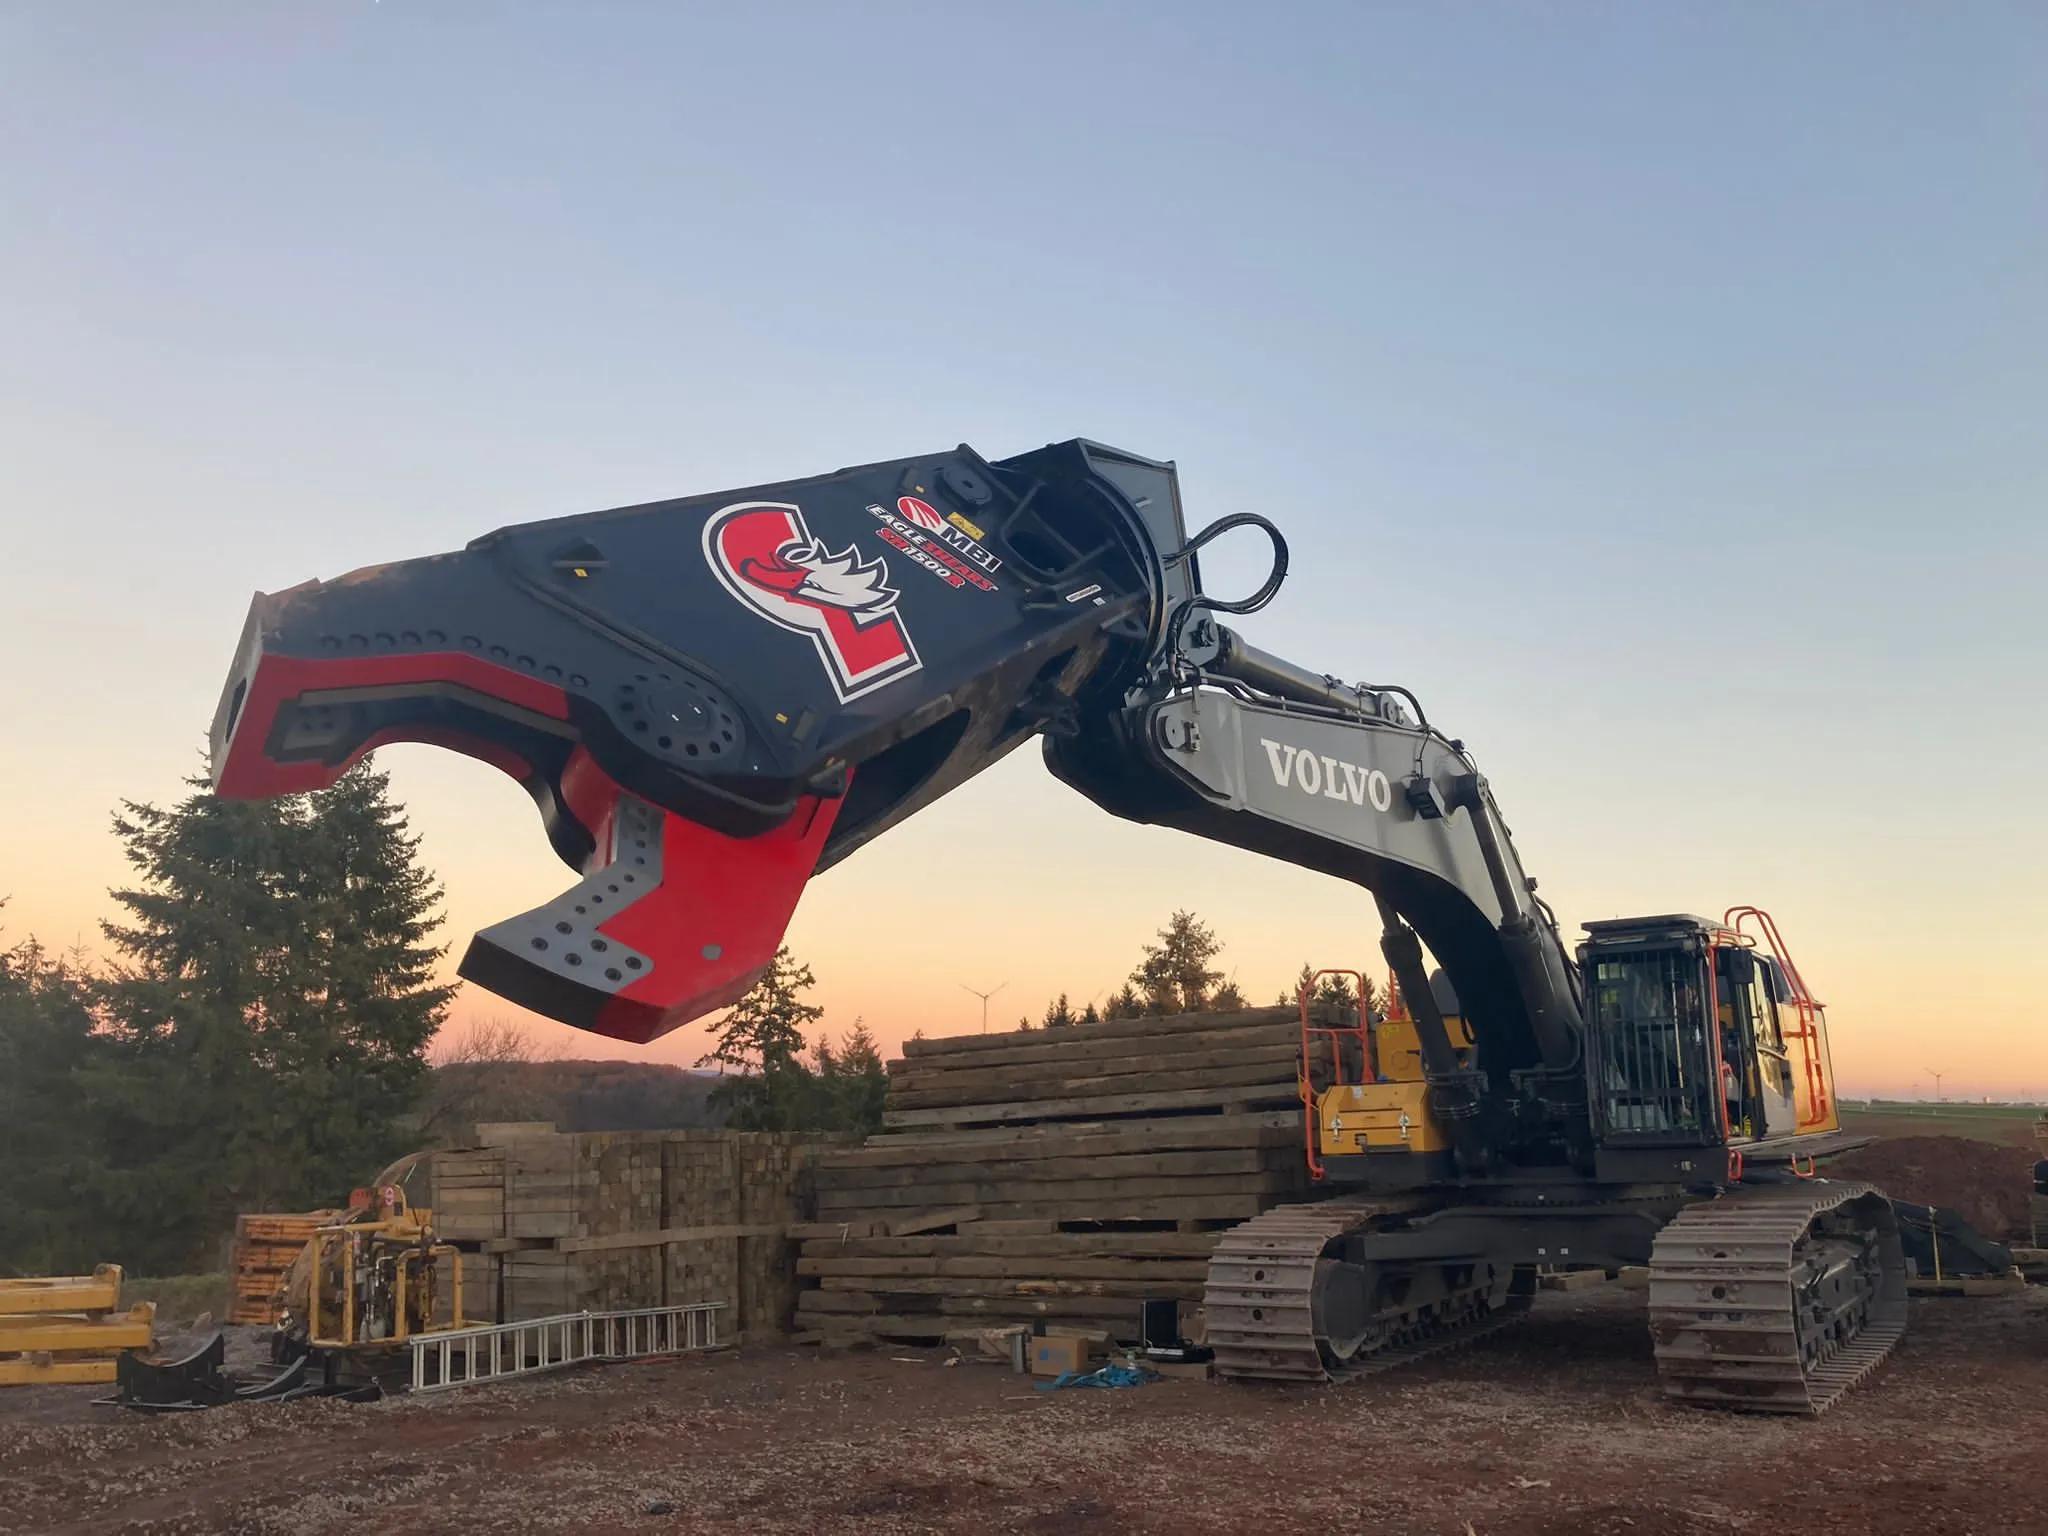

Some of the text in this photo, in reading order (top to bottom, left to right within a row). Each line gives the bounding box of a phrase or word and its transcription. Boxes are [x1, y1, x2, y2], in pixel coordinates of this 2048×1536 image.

[870, 505, 928, 545] EAGLE
[940, 526, 1001, 570] MBI
[1260, 738, 1391, 812] VOLVO
